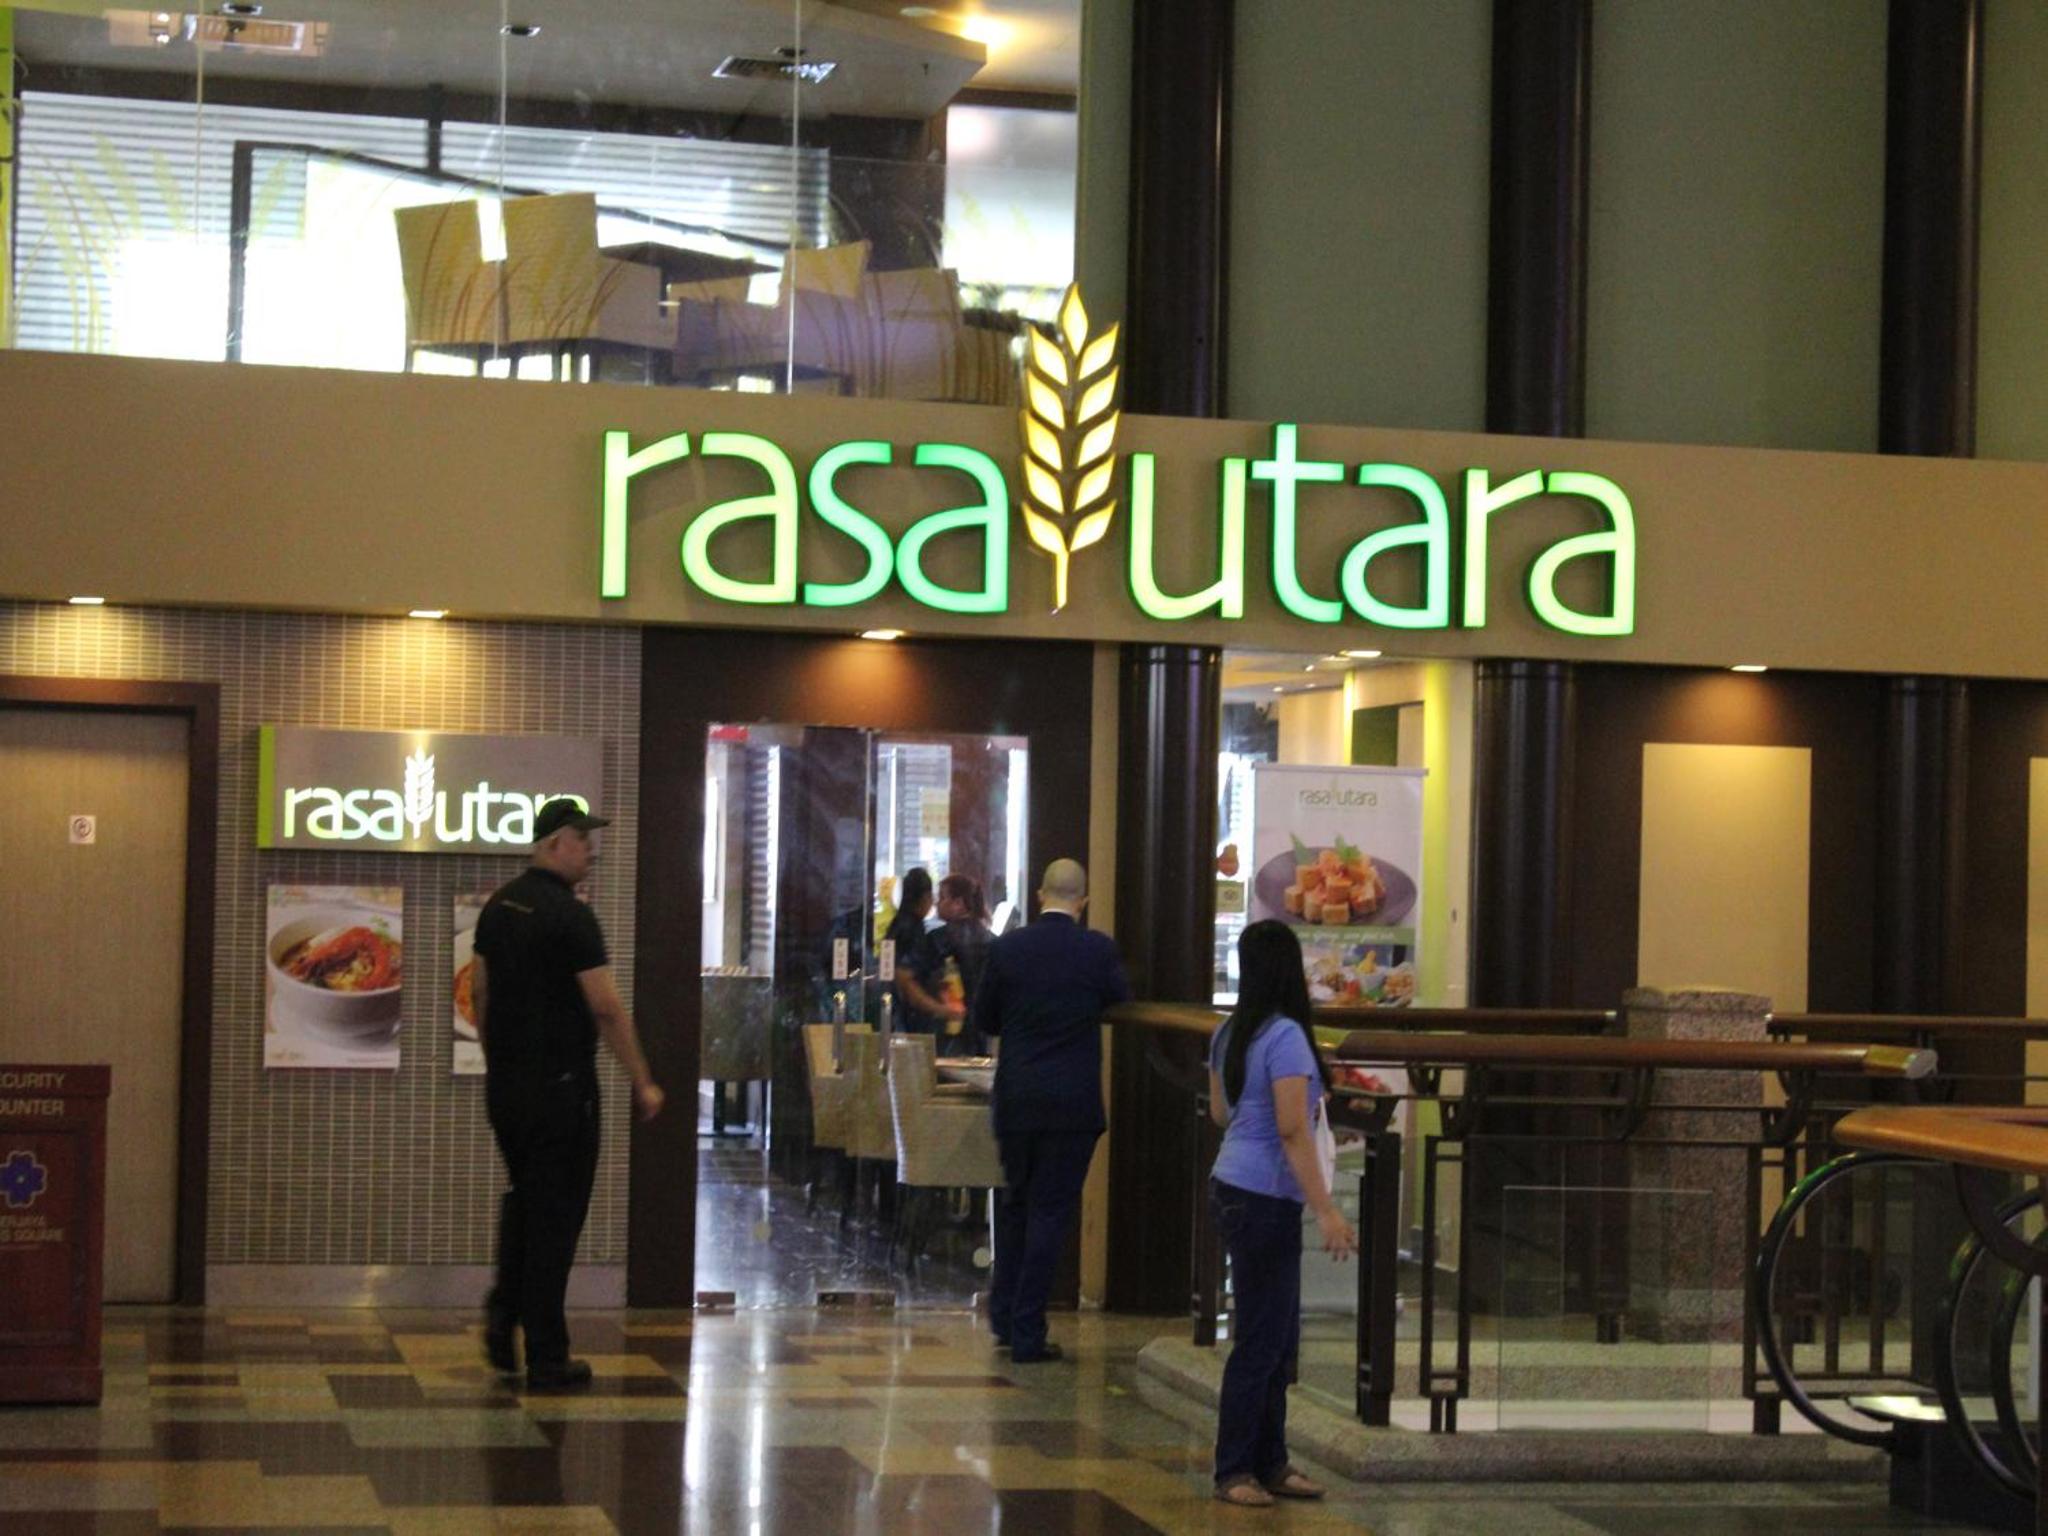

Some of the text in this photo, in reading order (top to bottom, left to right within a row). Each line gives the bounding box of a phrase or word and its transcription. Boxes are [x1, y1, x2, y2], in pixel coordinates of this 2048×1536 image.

[601, 422, 1637, 637] rasa utara
[284, 786, 405, 841] rasa
[1299, 786, 1378, 807] rasa utara
[0, 1072, 66, 1089] CURITY
